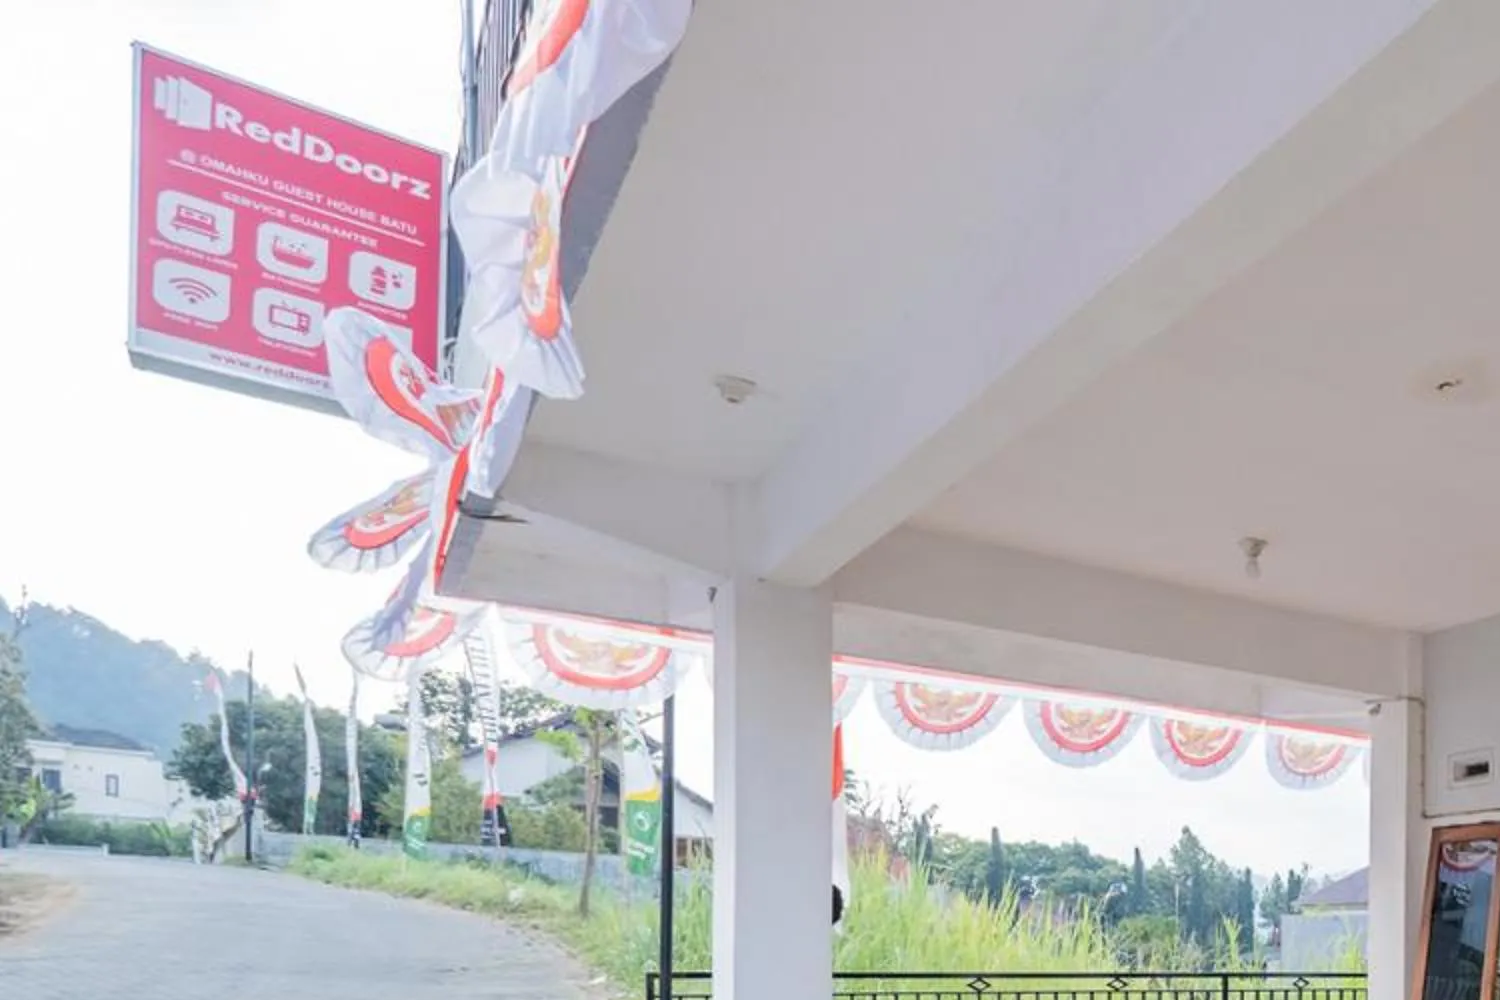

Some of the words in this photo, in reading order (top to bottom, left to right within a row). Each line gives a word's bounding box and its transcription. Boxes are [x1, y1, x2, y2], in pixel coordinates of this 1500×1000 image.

[215, 101, 432, 201] RedDoorz
[201, 155, 269, 185] OMAHKU
[272, 179, 323, 204] GUEST
[326, 197, 376, 222] HOUSE
[379, 214, 417, 236] BATU
[221, 191, 286, 218] SERVICE
[289, 212, 378, 248] GUARANTEE
